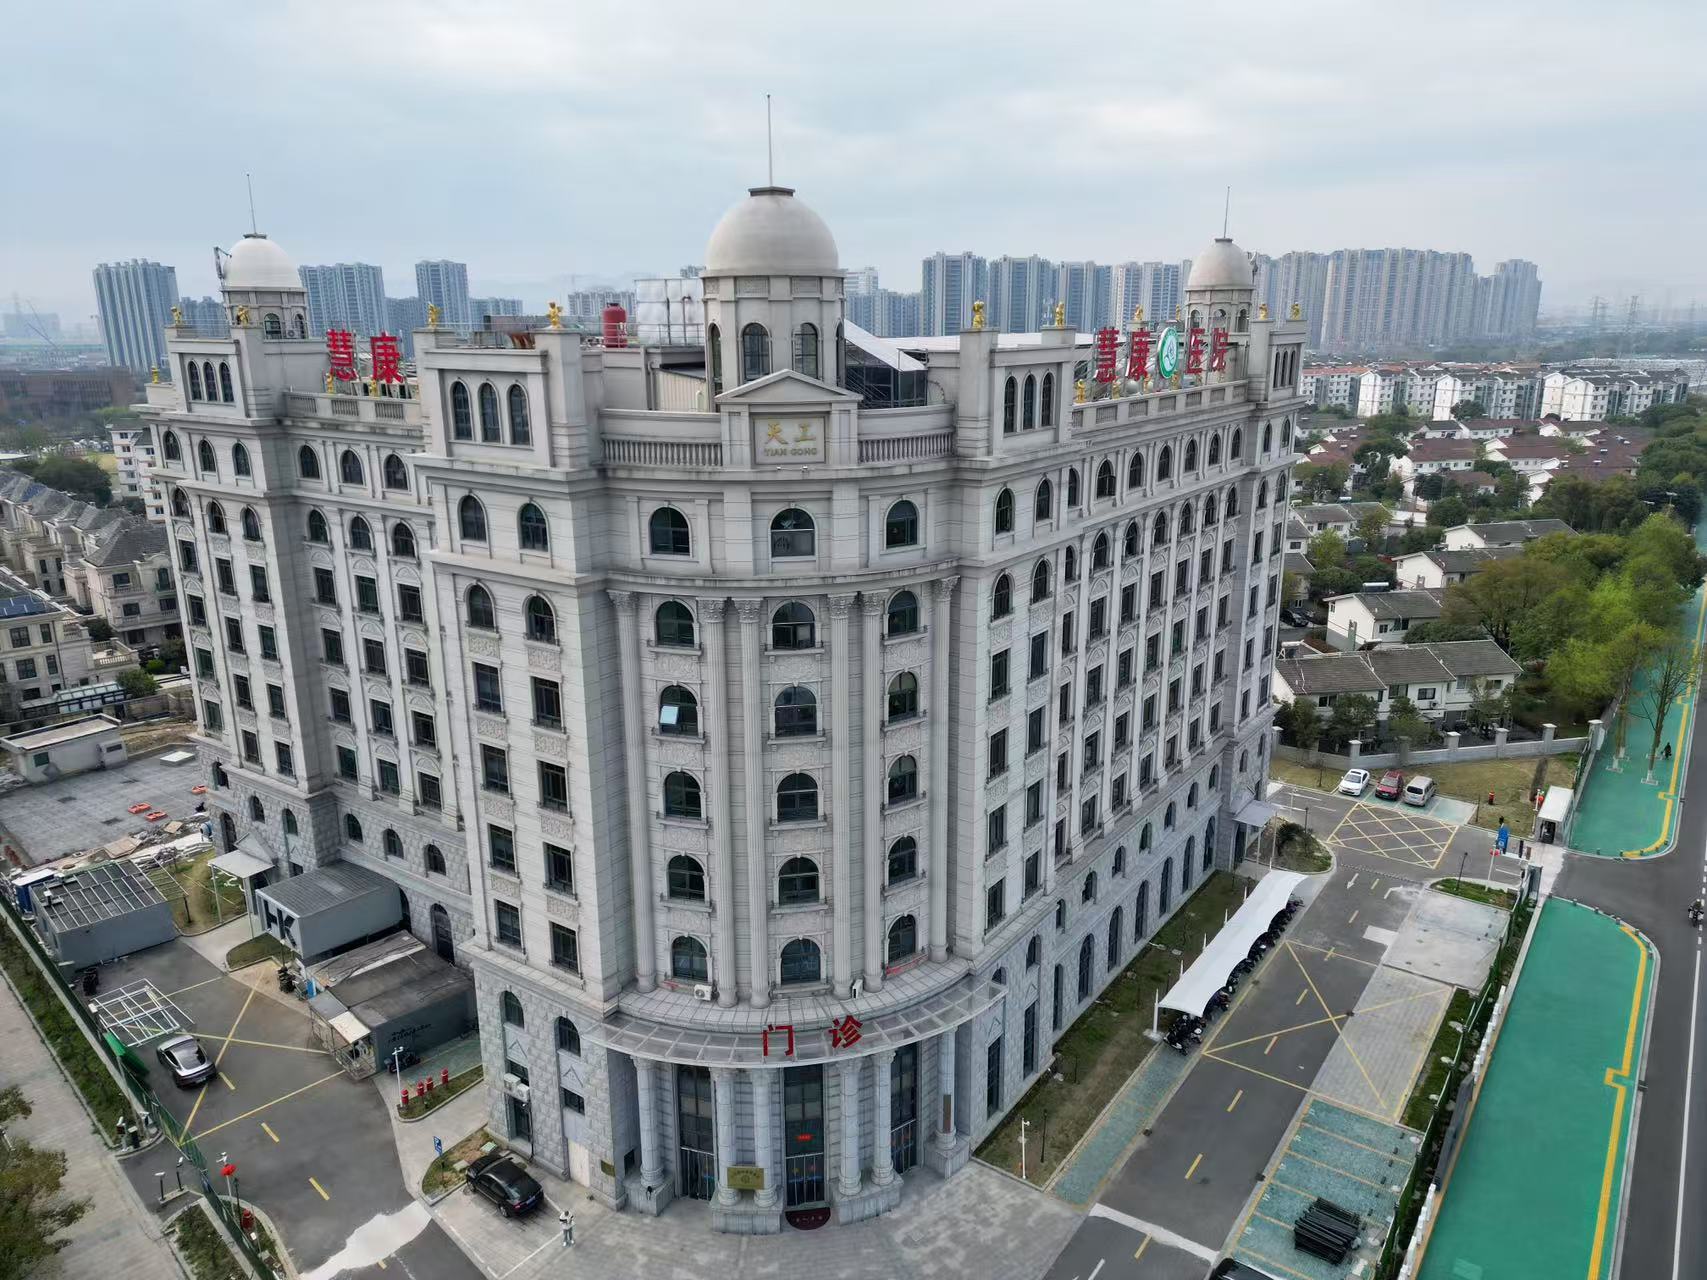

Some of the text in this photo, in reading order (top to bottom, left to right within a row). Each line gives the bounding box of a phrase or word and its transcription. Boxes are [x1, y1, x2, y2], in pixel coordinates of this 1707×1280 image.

[326, 327, 404, 384] 慧康
[790, 447, 818, 456] GONG
[762, 1014, 864, 1057] 门诊
